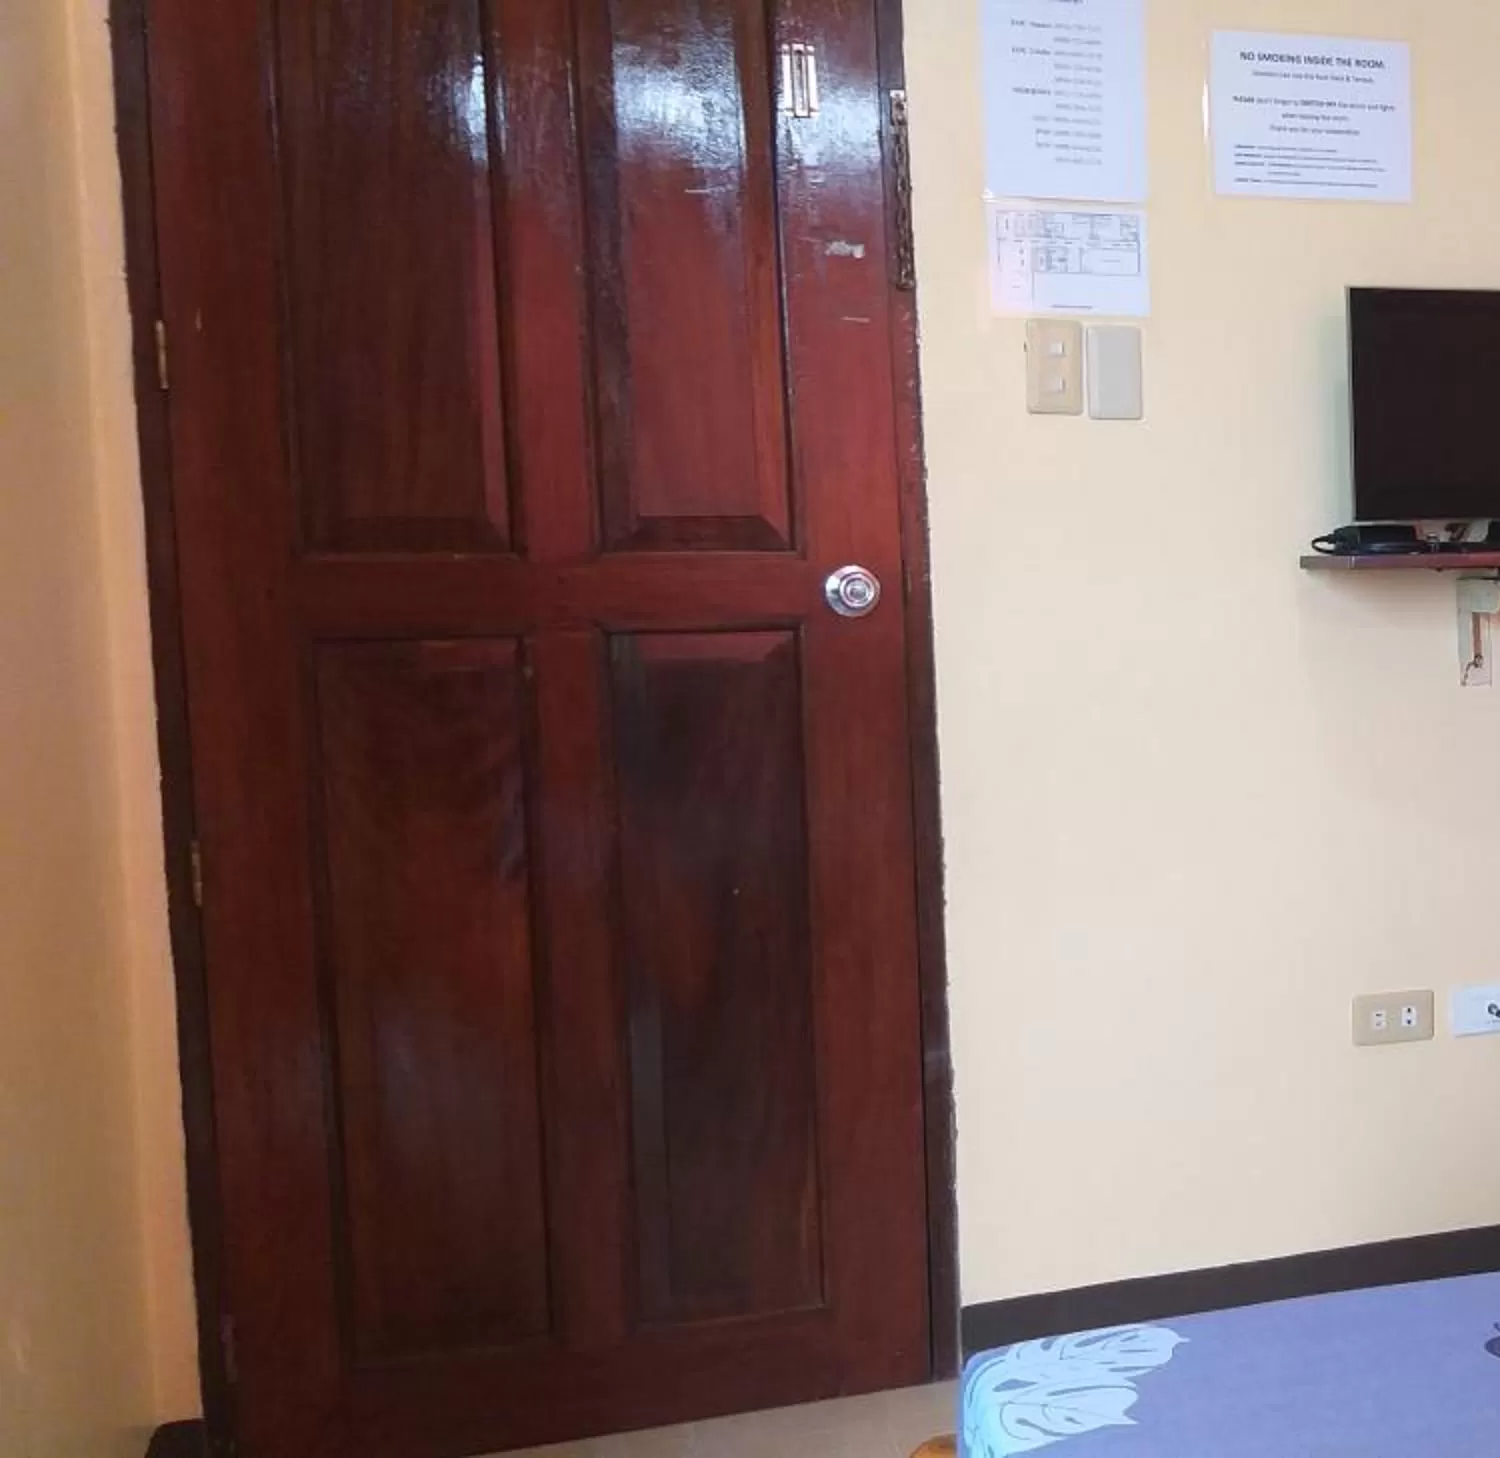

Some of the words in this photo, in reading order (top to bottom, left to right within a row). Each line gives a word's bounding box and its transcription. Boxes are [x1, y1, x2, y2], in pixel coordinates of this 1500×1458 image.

[1240, 51, 1255, 61] NO
[1257, 52, 1302, 65] SMOKING
[1304, 55, 1333, 66] INSIDE
[1335, 56, 1352, 68] THE
